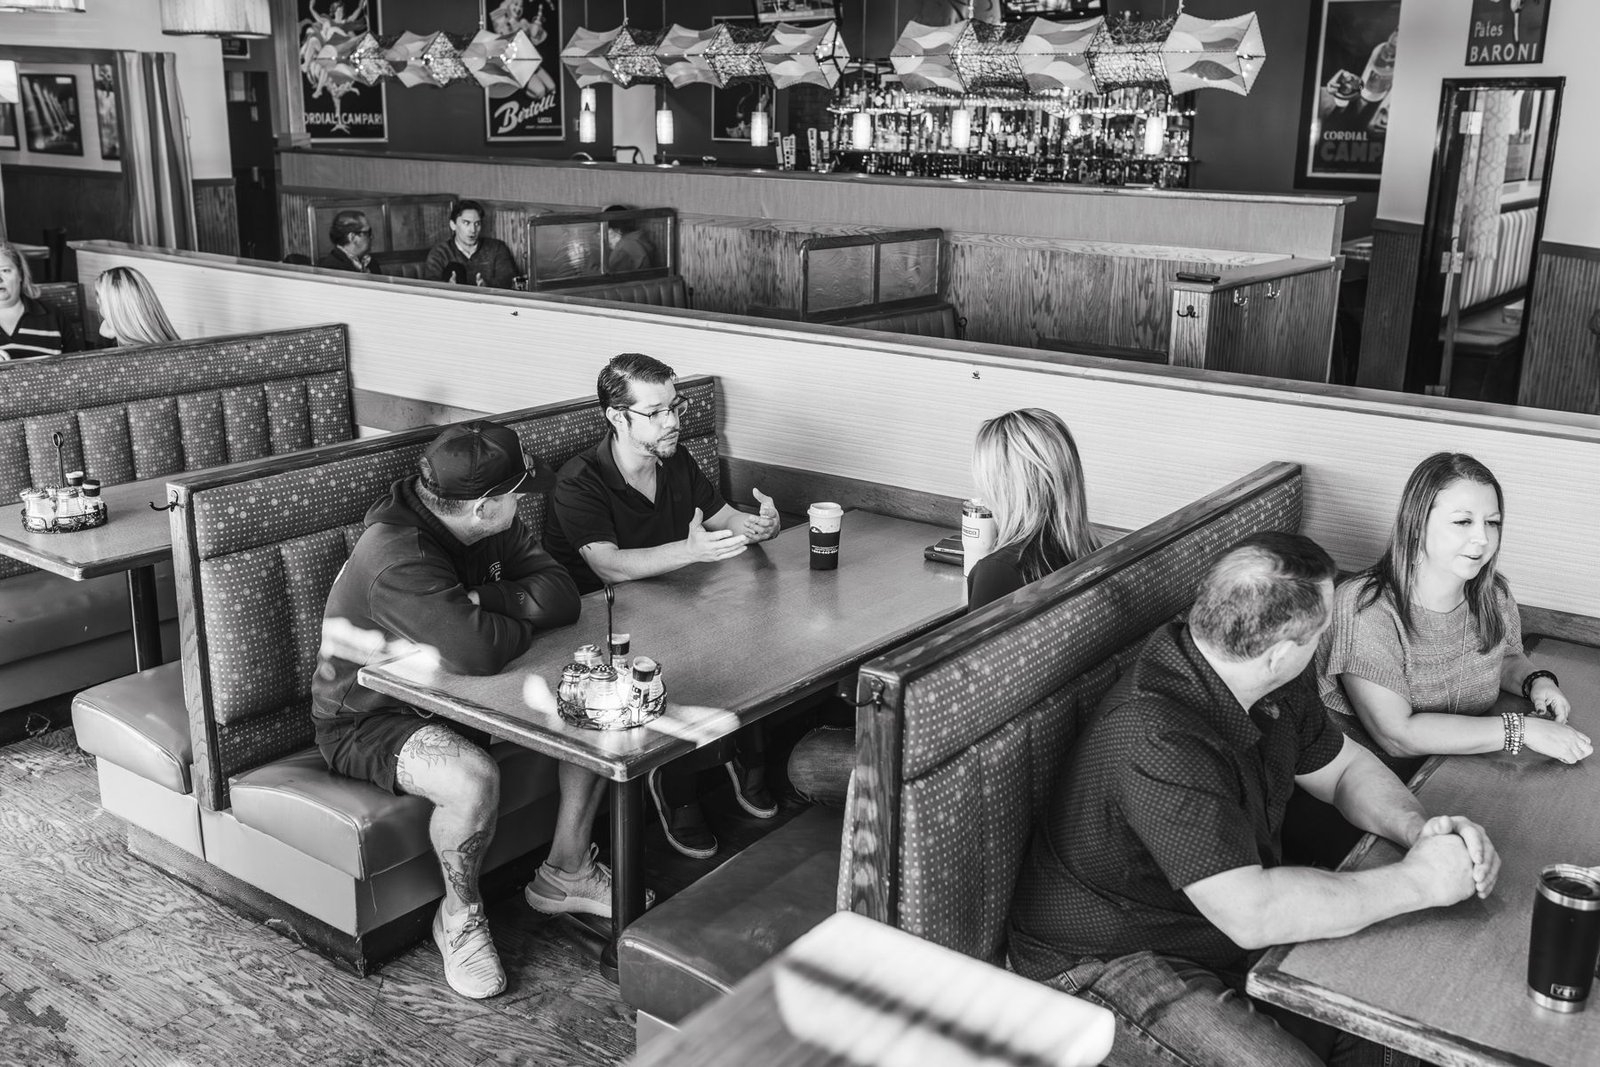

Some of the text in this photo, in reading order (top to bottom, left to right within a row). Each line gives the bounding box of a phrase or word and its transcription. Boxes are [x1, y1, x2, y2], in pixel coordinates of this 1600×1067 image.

[1470, 43, 1537, 62] BARONI
[303, 112, 337, 125] ORDIAL
[494, 90, 556, 134] Bertolli
[1323, 130, 1368, 141] CORDIAL
[1320, 141, 1384, 162] CAMP
